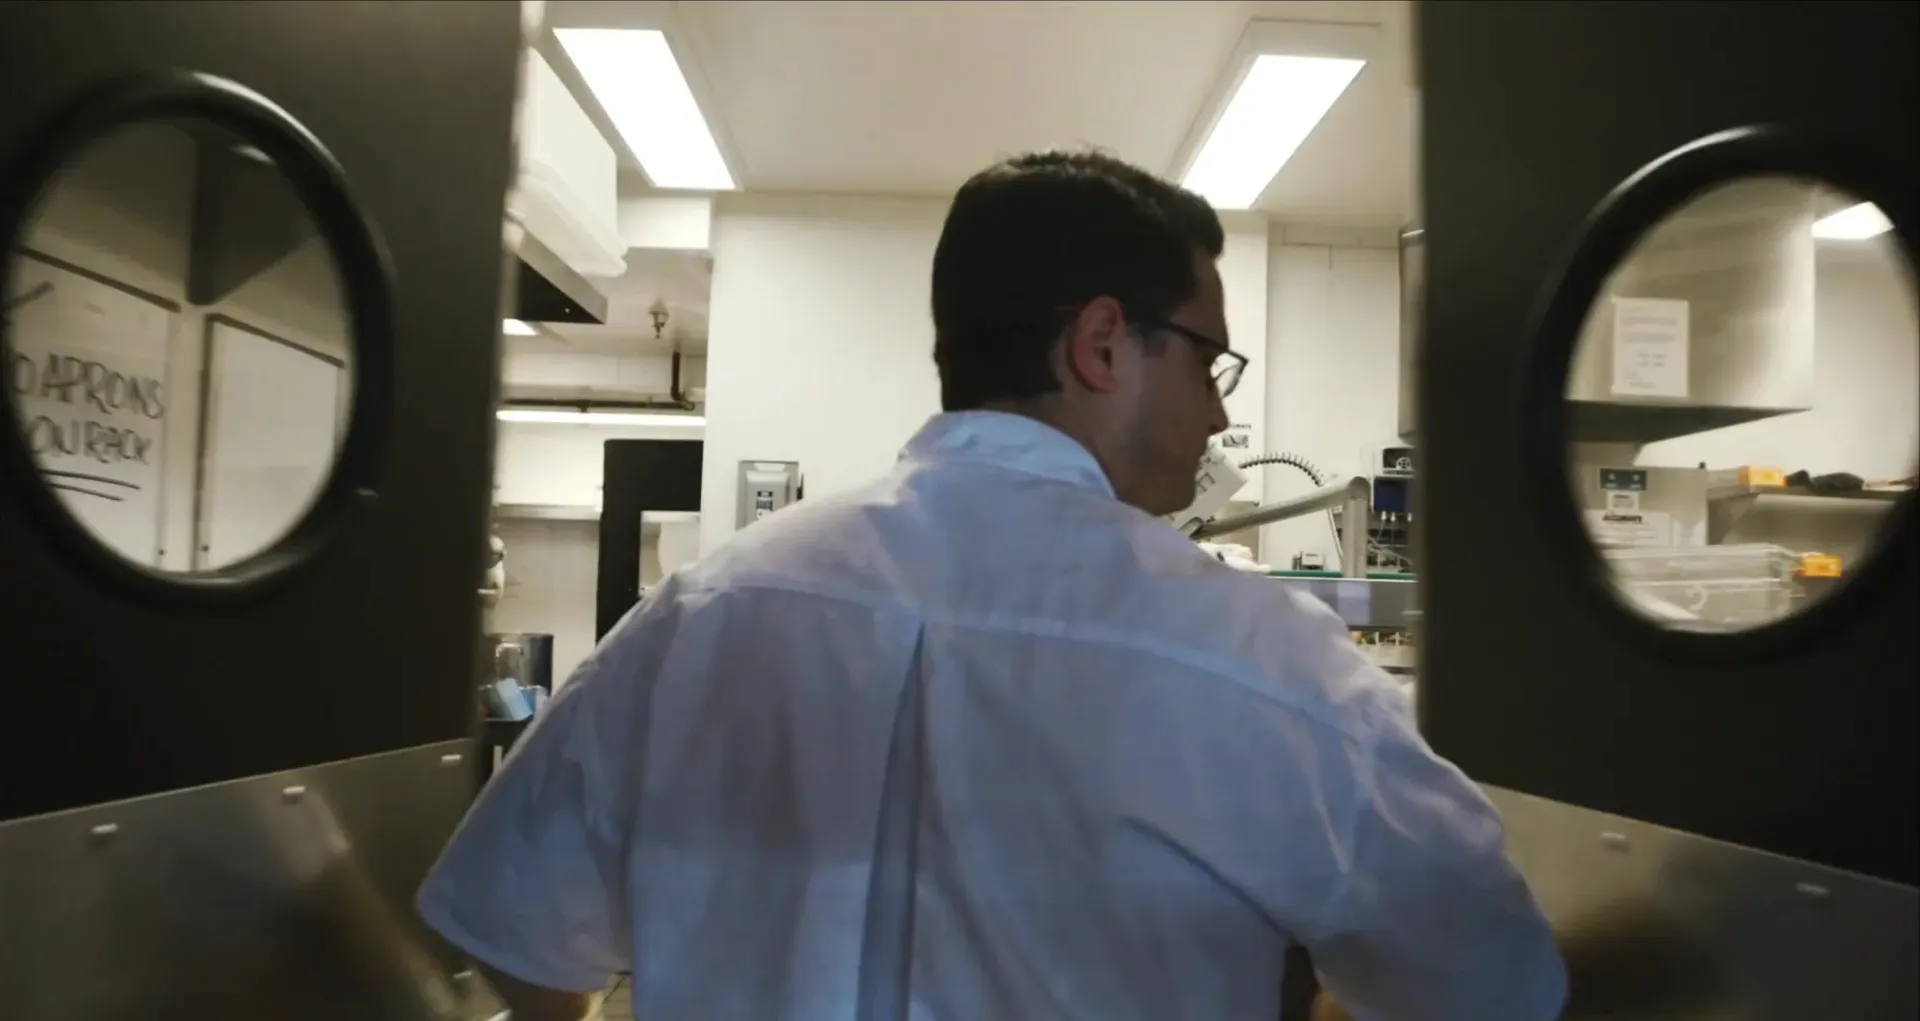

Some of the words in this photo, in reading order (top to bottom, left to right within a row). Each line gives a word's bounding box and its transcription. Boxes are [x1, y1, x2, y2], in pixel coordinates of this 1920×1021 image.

[40, 353, 164, 420] APRONS
[31, 415, 81, 457] ON
[84, 420, 153, 465] RACK
